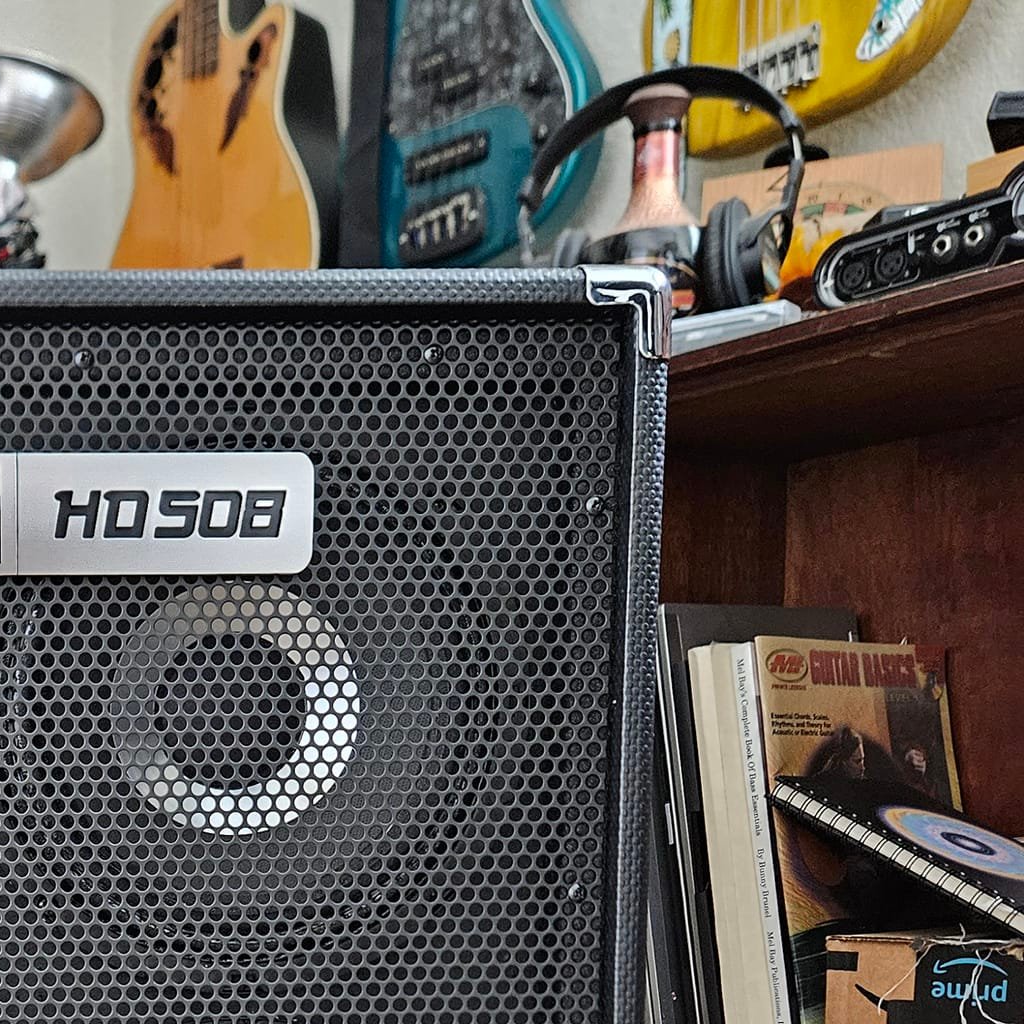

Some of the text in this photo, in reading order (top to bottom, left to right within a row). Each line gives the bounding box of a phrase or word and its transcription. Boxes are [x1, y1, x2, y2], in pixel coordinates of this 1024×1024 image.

[736, 658, 761, 837] Mel Bay's Complete Book Of Bass Essentials
[756, 848, 771, 918] By Bunny Brunel
[767, 931, 775, 947] Mel
[931, 979, 1008, 1007] prime
